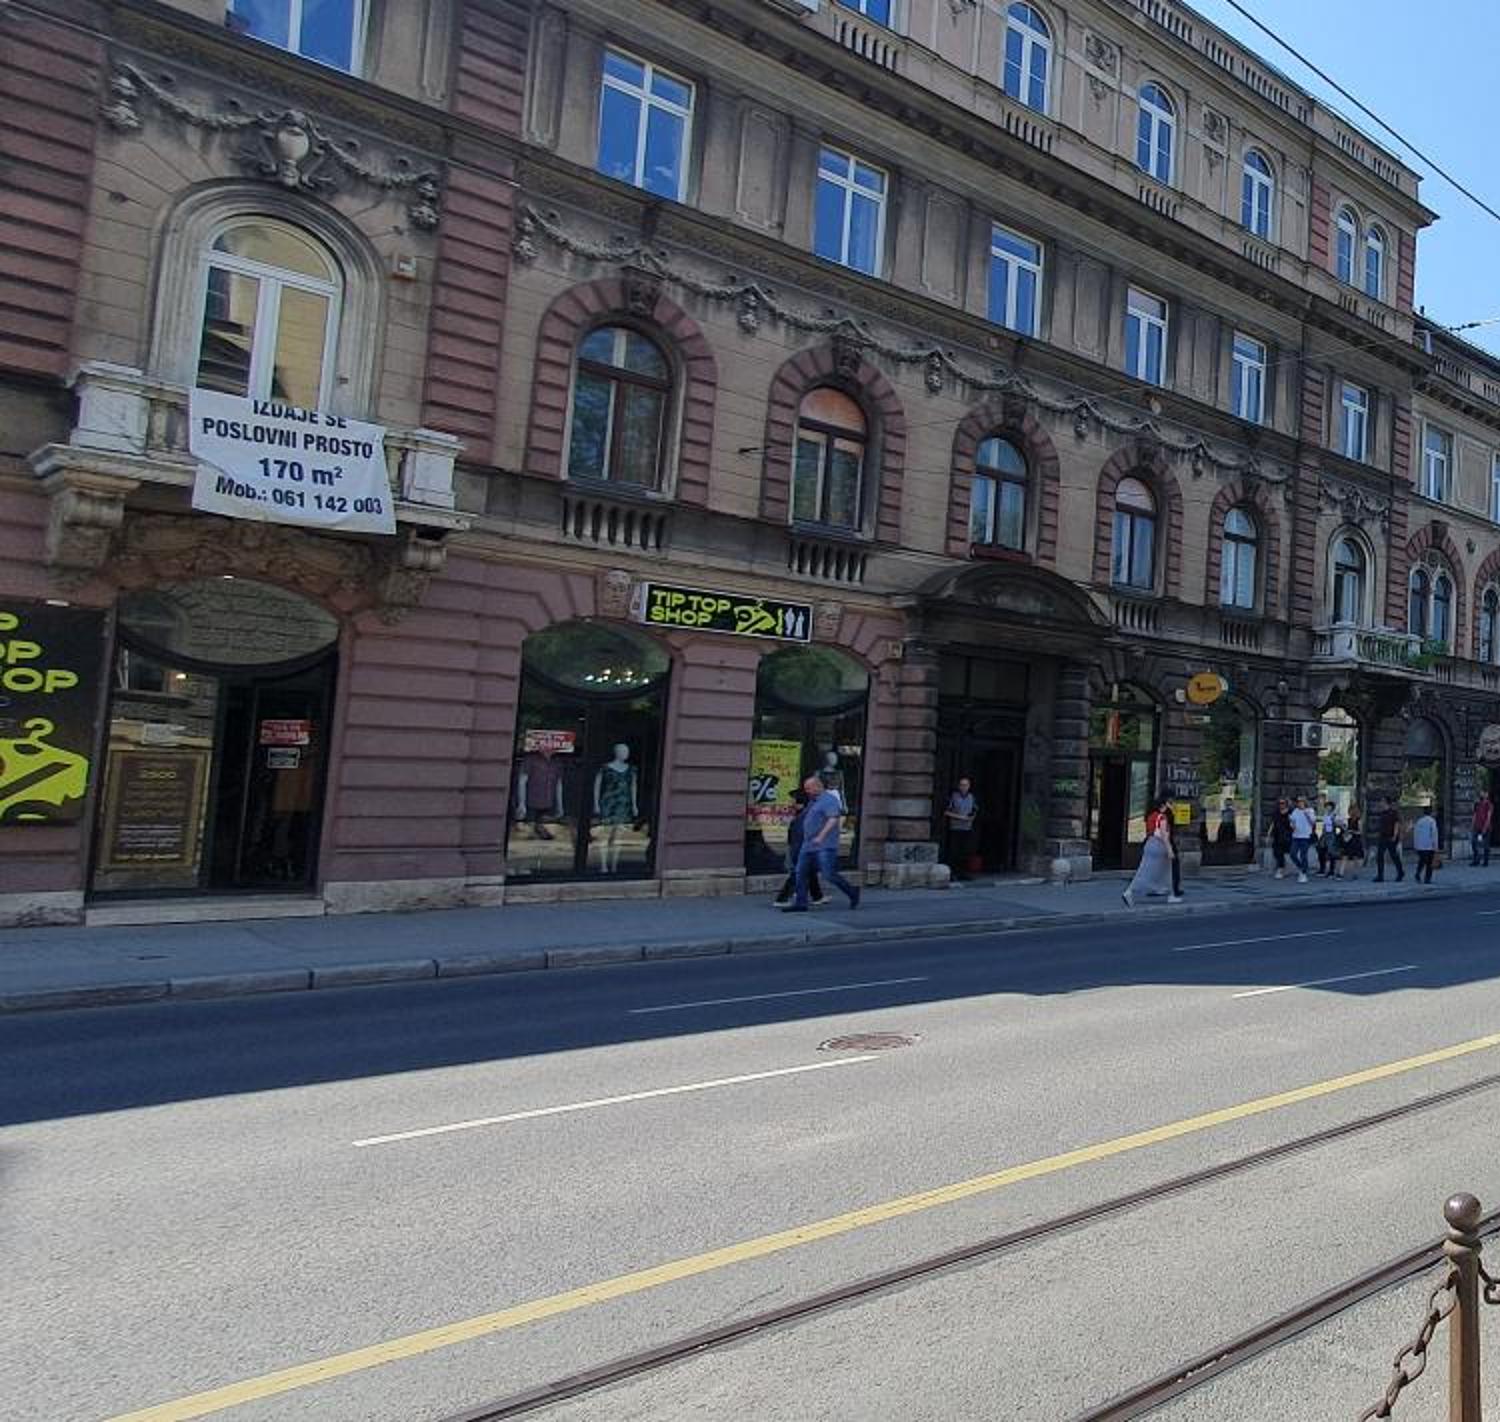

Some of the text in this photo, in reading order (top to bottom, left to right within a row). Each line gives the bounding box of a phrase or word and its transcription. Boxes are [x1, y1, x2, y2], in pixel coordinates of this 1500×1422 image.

[252, 400, 348, 429] IZDAJE SE
[202, 417, 373, 460] POSLOVNI PROSTO
[258, 457, 304, 482] 170
[215, 475, 383, 515] Mob.: 061 142 003
[651, 589, 731, 614] TIP TOP
[650, 605, 713, 627] SHOP
